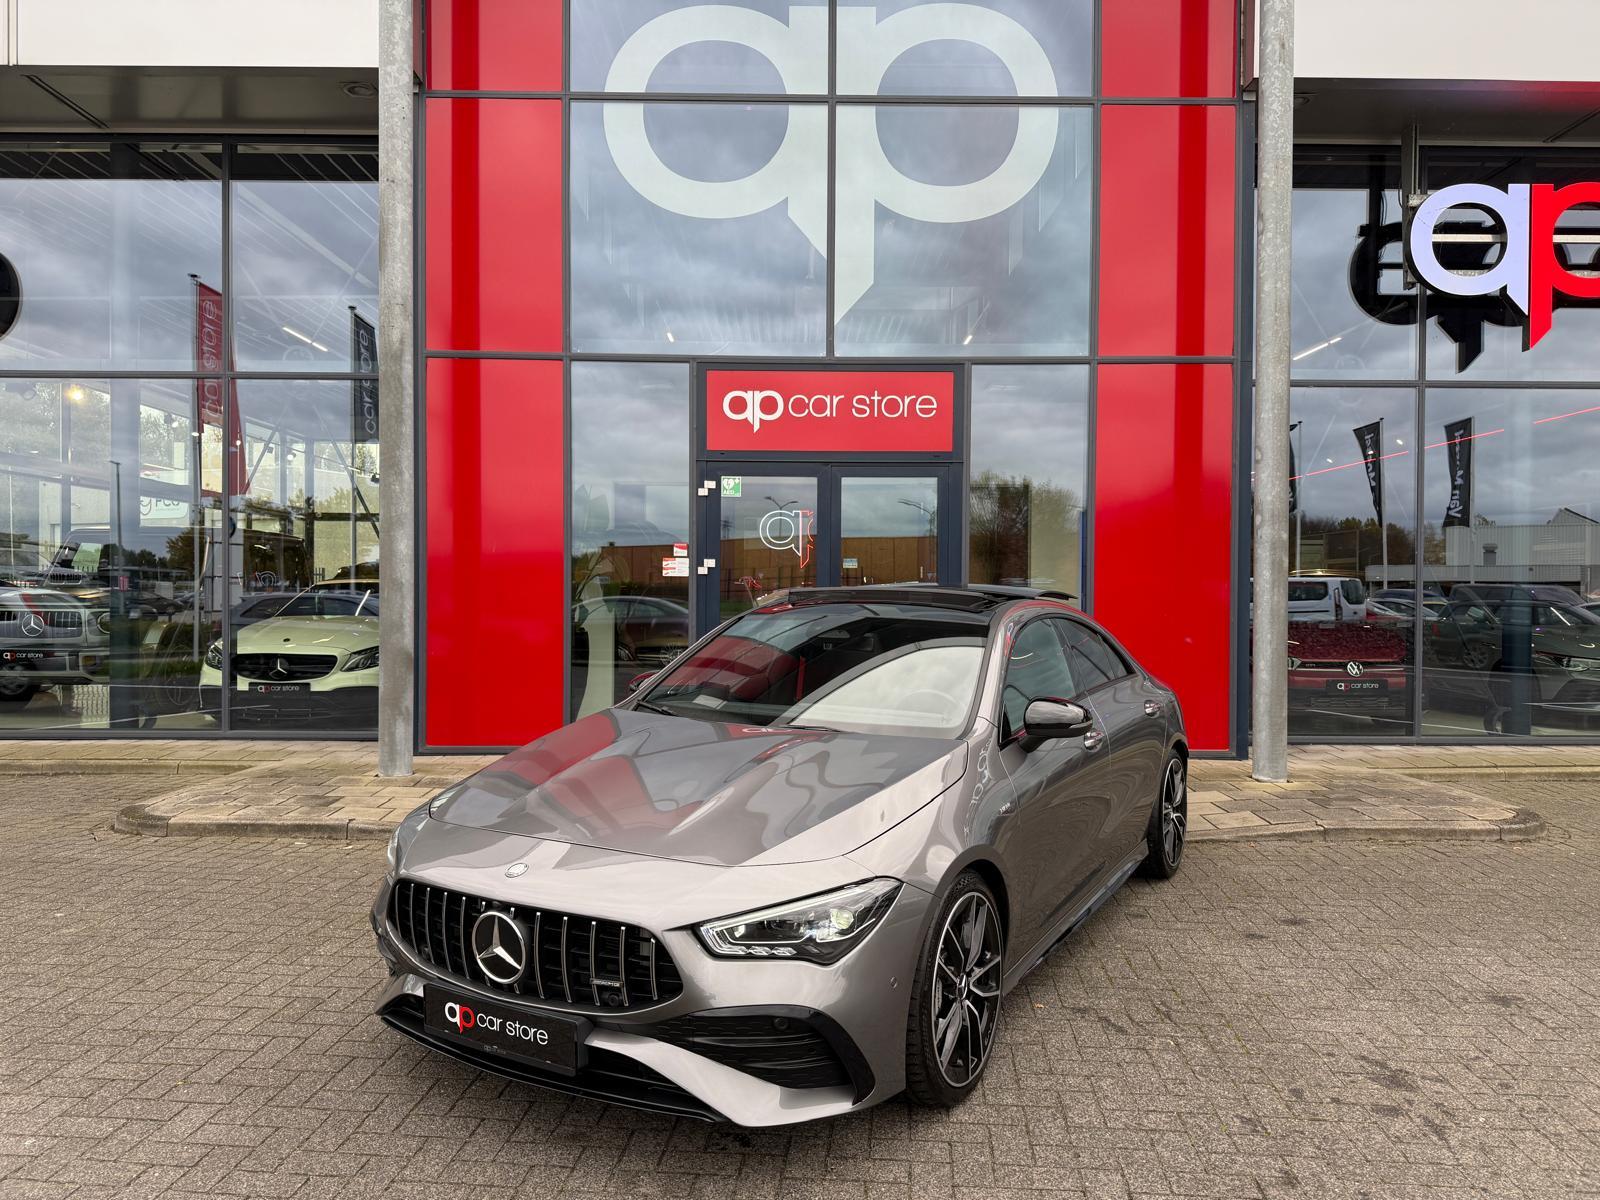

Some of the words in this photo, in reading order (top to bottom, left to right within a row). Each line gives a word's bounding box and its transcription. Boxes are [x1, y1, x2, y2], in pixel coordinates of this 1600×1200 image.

[603, 2, 1058, 326] ap
[204, 377, 220, 417] ca
[363, 391, 377, 434] car
[722, 390, 784, 433] ap
[788, 394, 844, 418] car
[851, 390, 938, 418] store
[444, 1001, 475, 1034] ap
[476, 1013, 503, 1032] car
[505, 1020, 549, 1045] store
